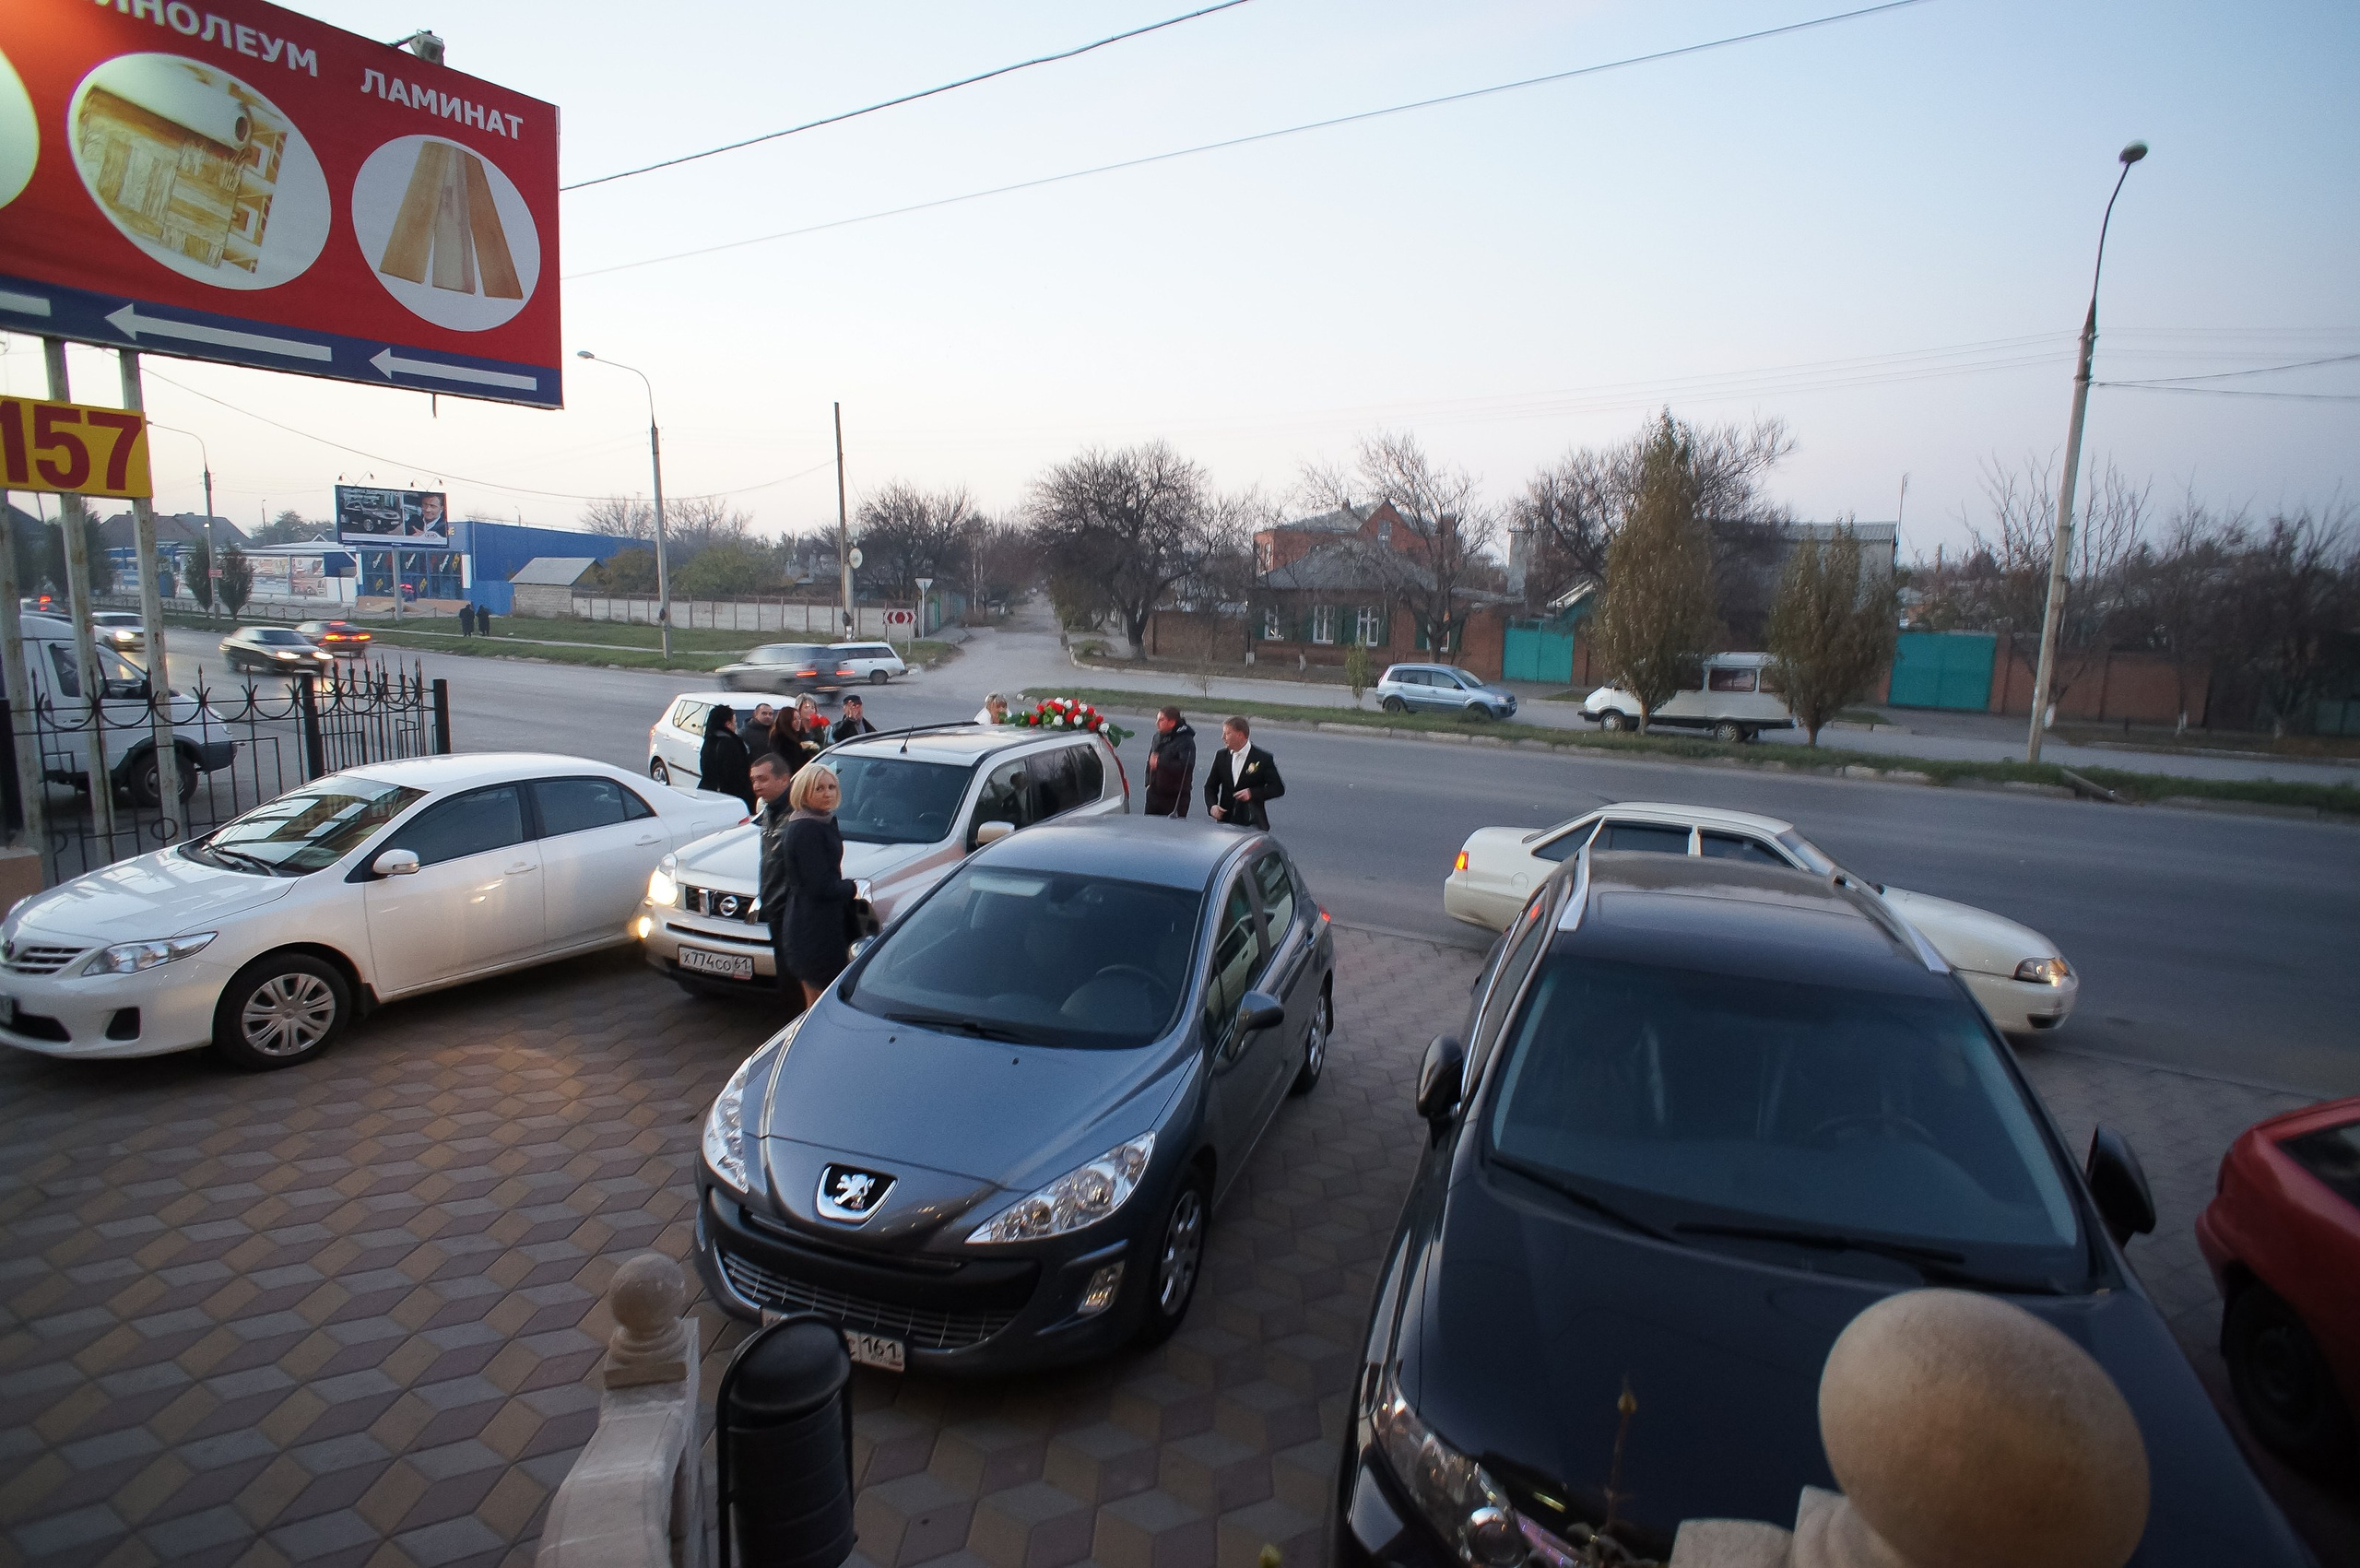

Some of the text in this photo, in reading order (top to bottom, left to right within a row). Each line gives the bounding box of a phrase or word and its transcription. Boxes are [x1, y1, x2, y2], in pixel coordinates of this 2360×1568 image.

[360, 68, 524, 140] ЛАМИНАТ
[0, 400, 142, 490] 157
[734, 957, 748, 970] 61
[862, 1336, 896, 1359] 161
